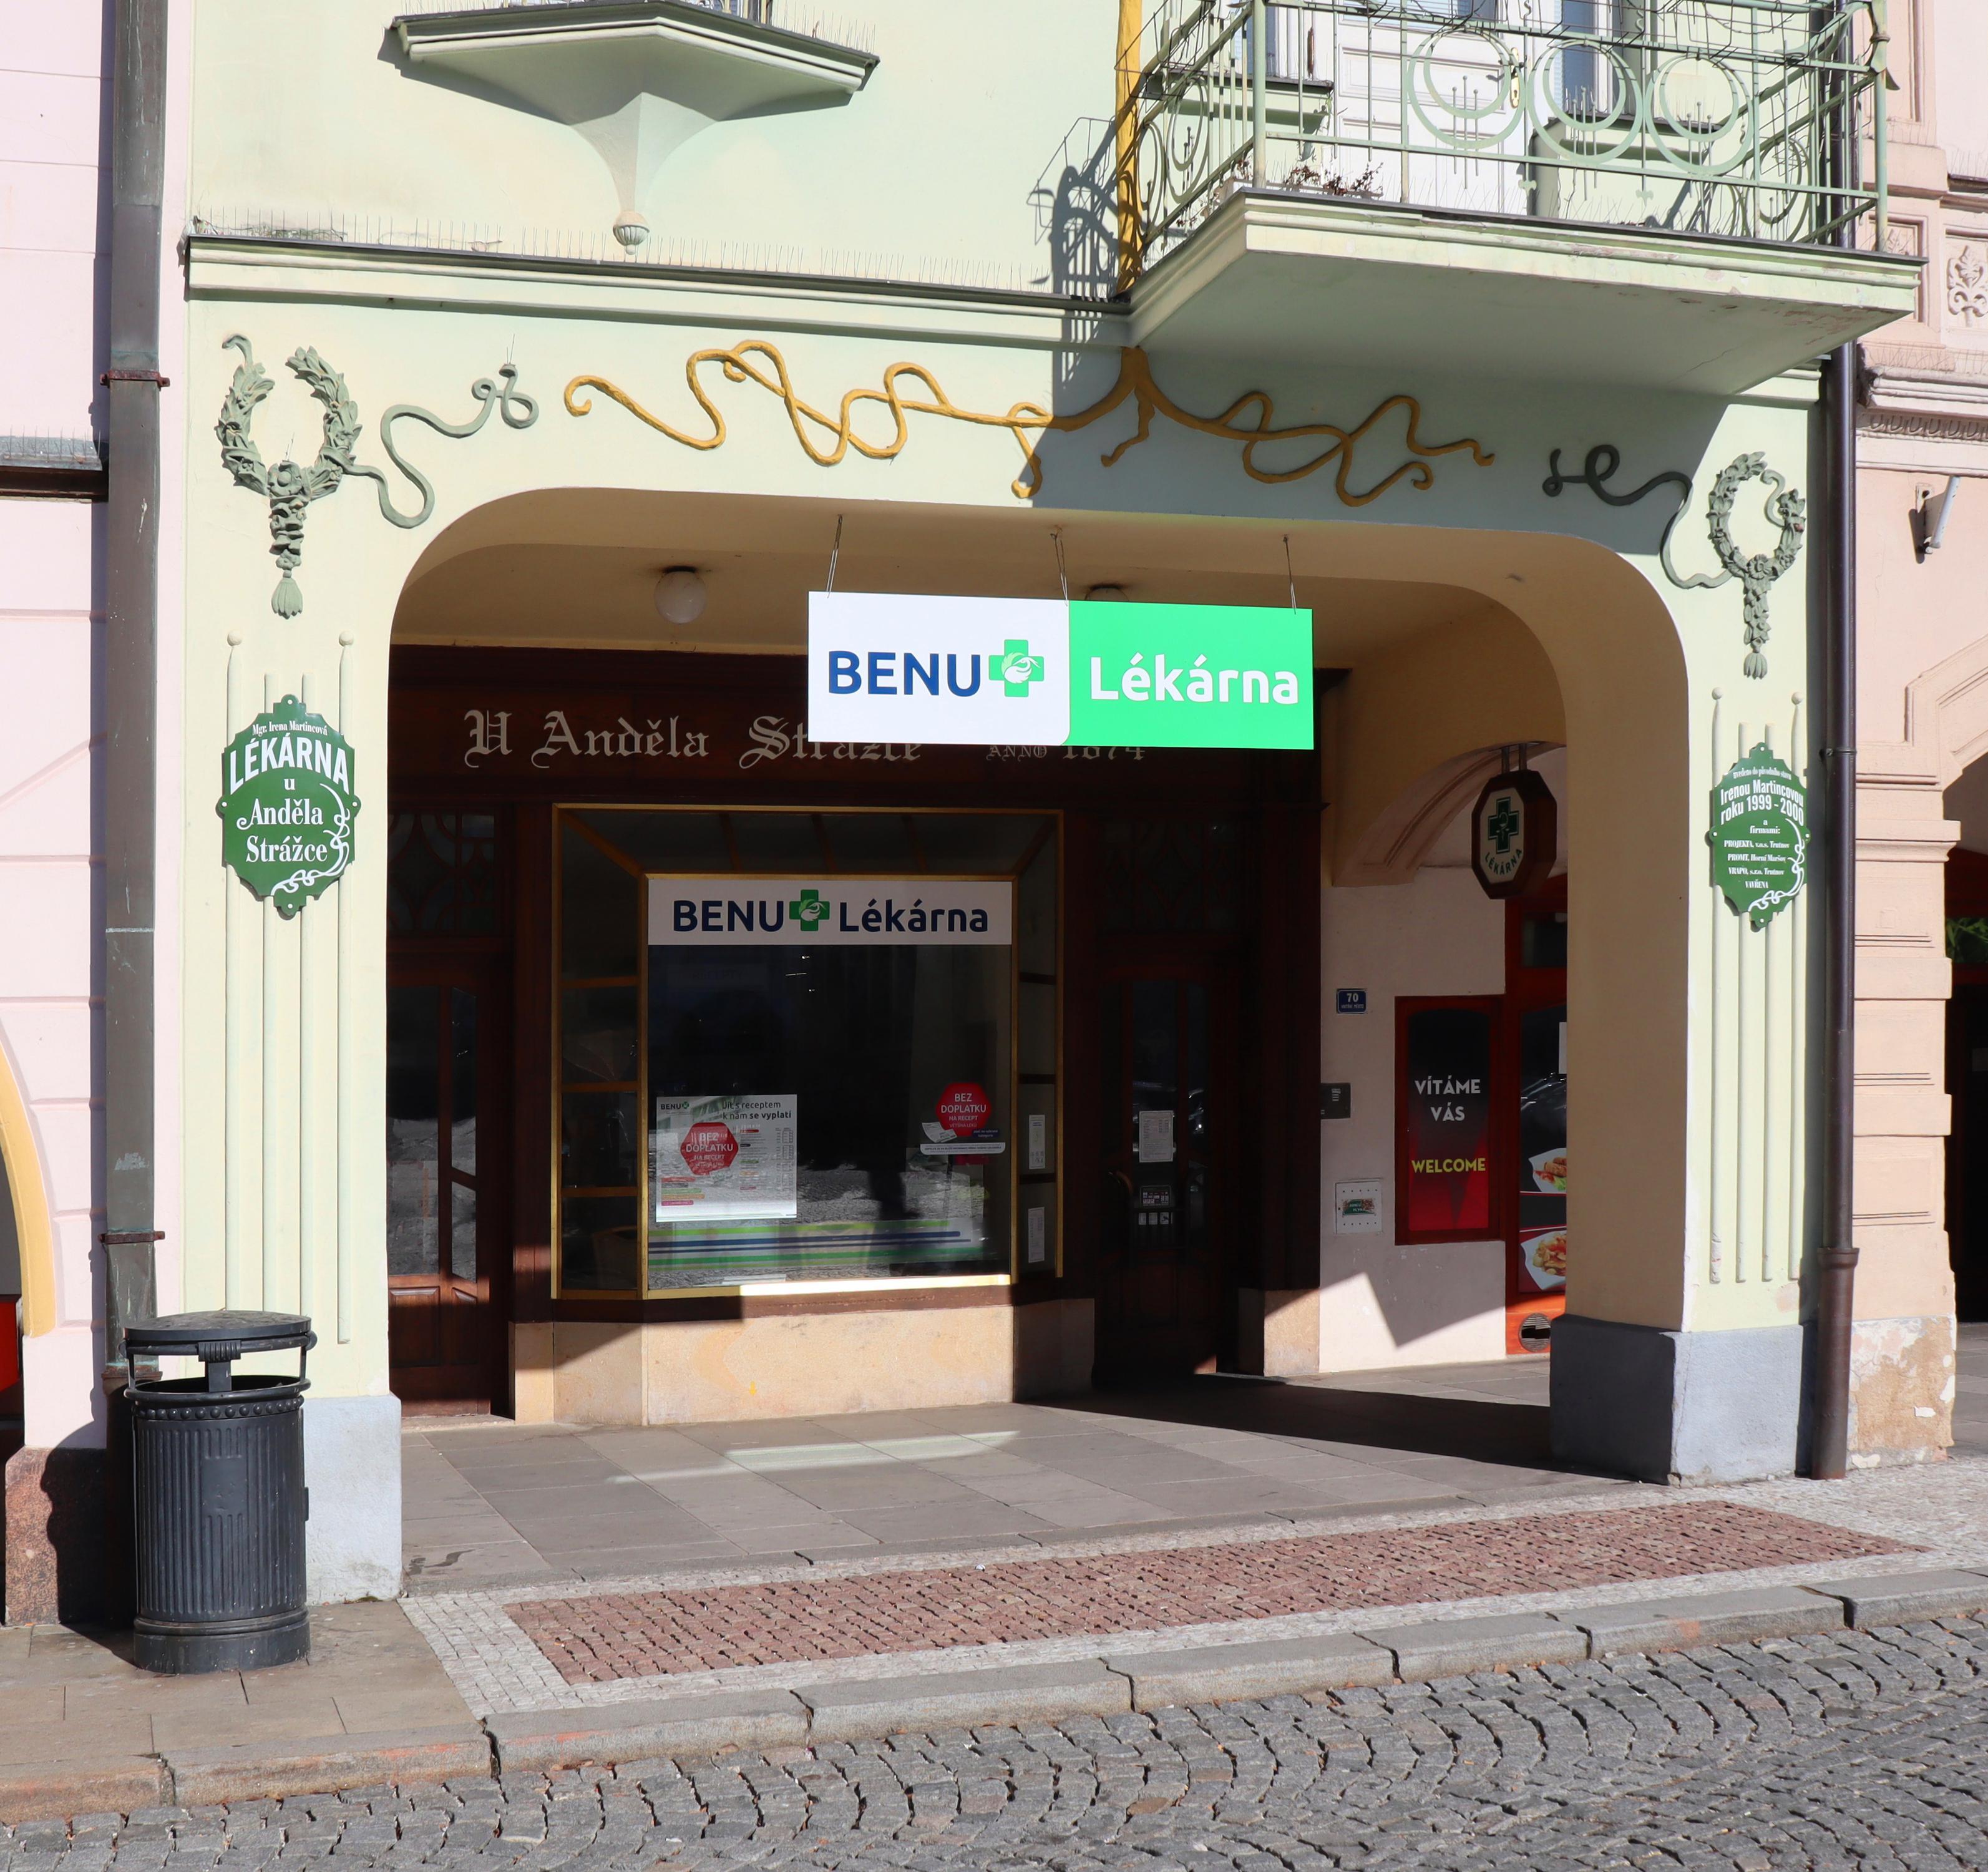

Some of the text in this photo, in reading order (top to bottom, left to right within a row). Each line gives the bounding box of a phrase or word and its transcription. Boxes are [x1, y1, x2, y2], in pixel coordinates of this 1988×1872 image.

[829, 650, 1299, 705] BENU Lékárna
[252, 720, 328, 737] Mgr. Irena Martincová
[531, 710, 709, 769] Anděla
[230, 733, 350, 796] LÉKÁRNA
[283, 778, 296, 791] u
[1720, 779, 1804, 807] Irenou Martincovou
[236, 798, 324, 831] Anděla
[1720, 801, 1744, 826] roku
[1747, 794, 1772, 812] 1999
[1780, 797, 1804, 826] 2000
[1750, 825, 1781, 834] firmami:
[245, 836, 328, 863] Strážce
[1484, 849, 1523, 875] LÉKÁRNA
[673, 899, 988, 932] BENU Lékárna
[1347, 993, 1358, 1003] 70
[1415, 1075, 1481, 1094] VÍTÁME
[741, 1101, 781, 1111] receptem
[954, 1093, 973, 1103] BEZ
[723, 1111, 727, 1120] k
[733, 1111, 748, 1120] nám
[762, 1110, 791, 1121] vyplatí
[940, 1104, 987, 1114] DOPLATKU
[1430, 1101, 1465, 1122] VÁS
[686, 1144, 734, 1153] DOPLATKU
[1411, 1159, 1486, 1173] WELCOME
